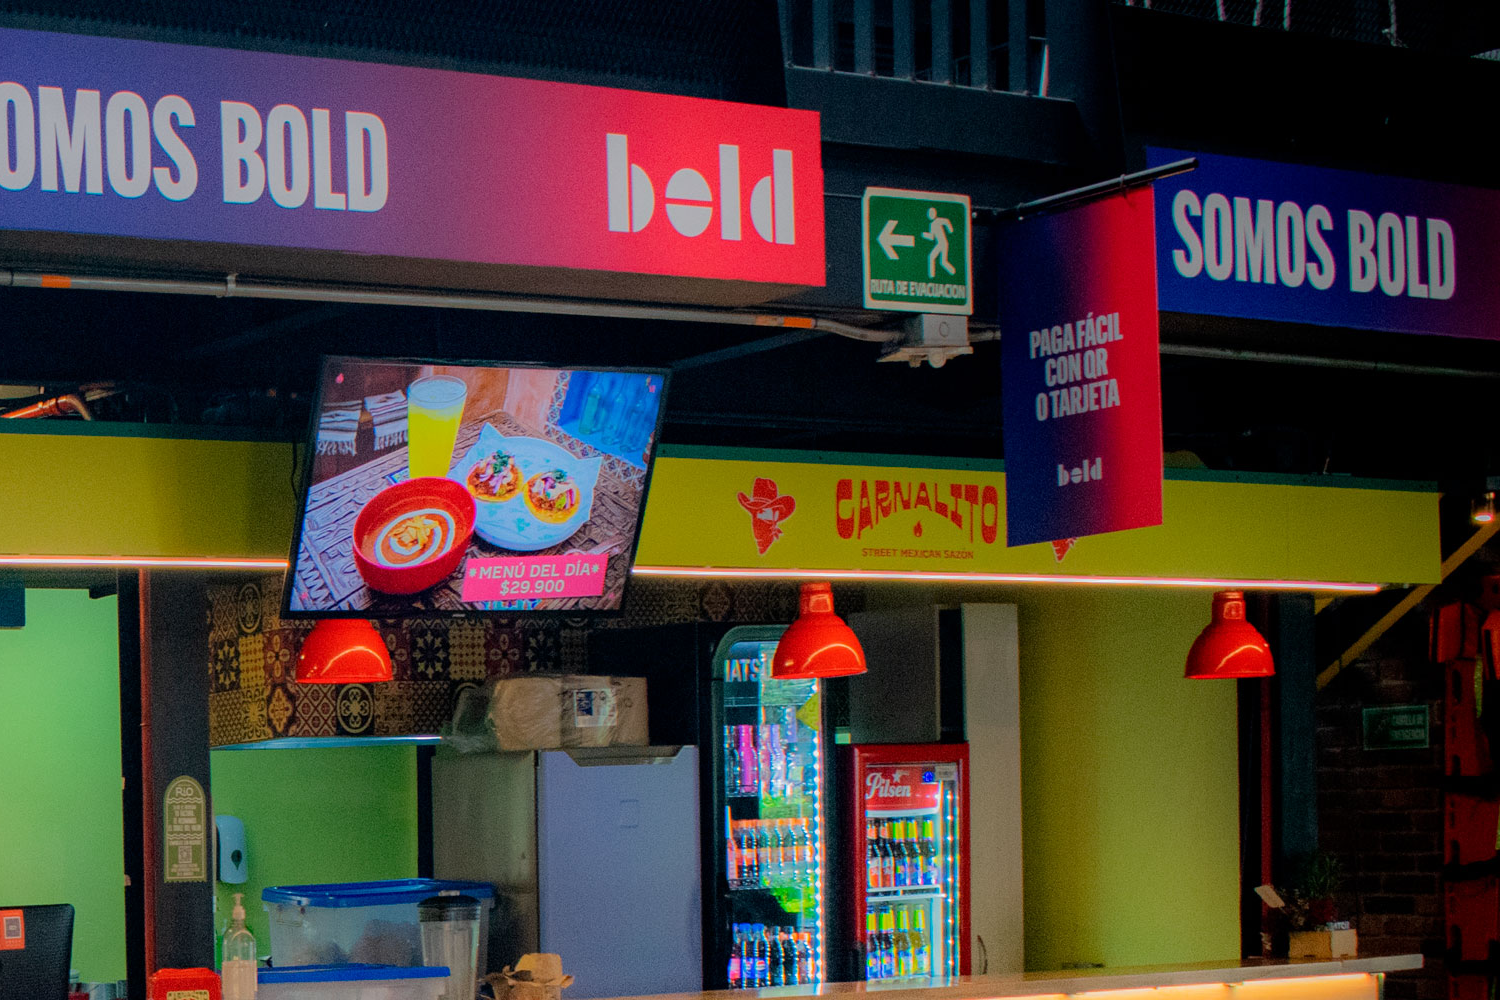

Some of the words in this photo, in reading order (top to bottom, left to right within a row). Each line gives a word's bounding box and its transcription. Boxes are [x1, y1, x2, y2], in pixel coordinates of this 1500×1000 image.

[220, 101, 388, 212] BOLD
[606, 133, 795, 245] bold
[1172, 189, 1336, 291] SOMOS
[1347, 208, 1456, 301] BOLD
[870, 279, 895, 294] RUTA
[896, 280, 909, 295] DE
[1029, 323, 1076, 360] PAGA
[1076, 312, 1124, 349] FÁCIL
[1045, 352, 1082, 387] CON
[1083, 348, 1109, 379] QR
[1035, 392, 1049, 422] O
[1049, 378, 1121, 418] TARJETA
[1057, 457, 1102, 487] bold
[835, 478, 998, 545] CARNALITO
[478, 562, 525, 579] MENÚ
[529, 563, 560, 578] DEL
[564, 560, 590, 576] DÍA
[861, 547, 898, 558] STREET
[900, 548, 941, 559] MEXICAN
[500, 579, 565, 596] $29.900
[865, 772, 912, 800] Pilsen
